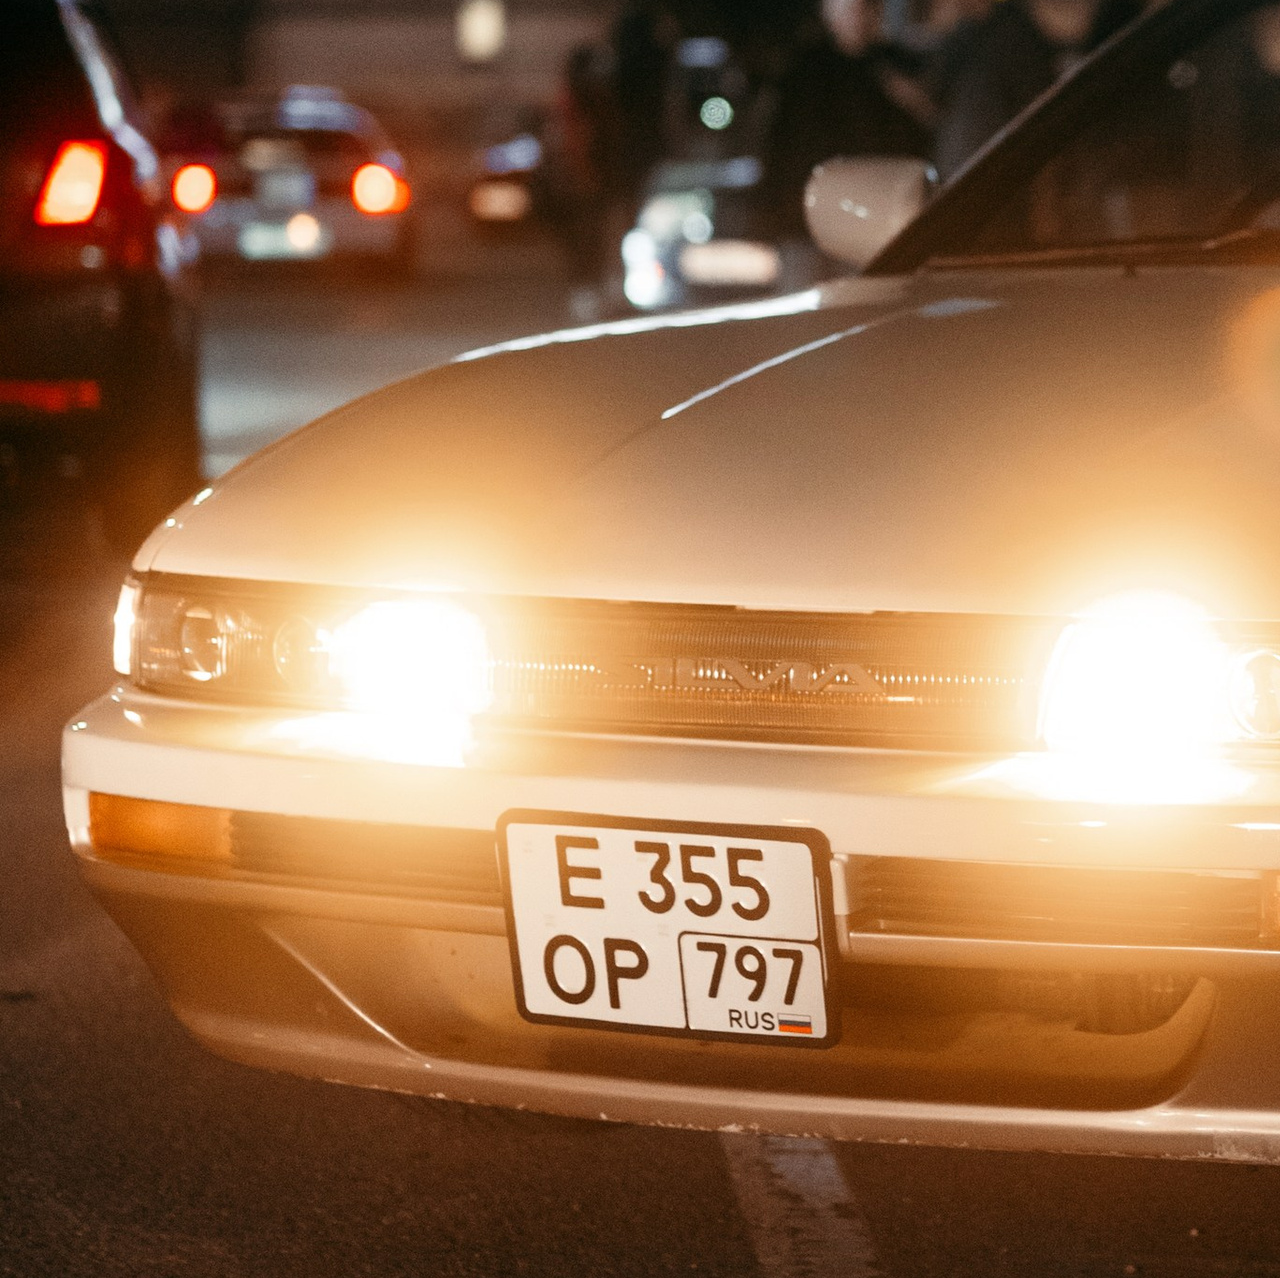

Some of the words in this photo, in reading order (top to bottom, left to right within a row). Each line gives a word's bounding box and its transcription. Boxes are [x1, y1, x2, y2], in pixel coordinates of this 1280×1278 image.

[555, 834, 605, 909] E
[634, 839, 770, 921] 355
[544, 934, 649, 1009] OP
[696, 941, 803, 1006] 797
[728, 1008, 776, 1031] RUS
